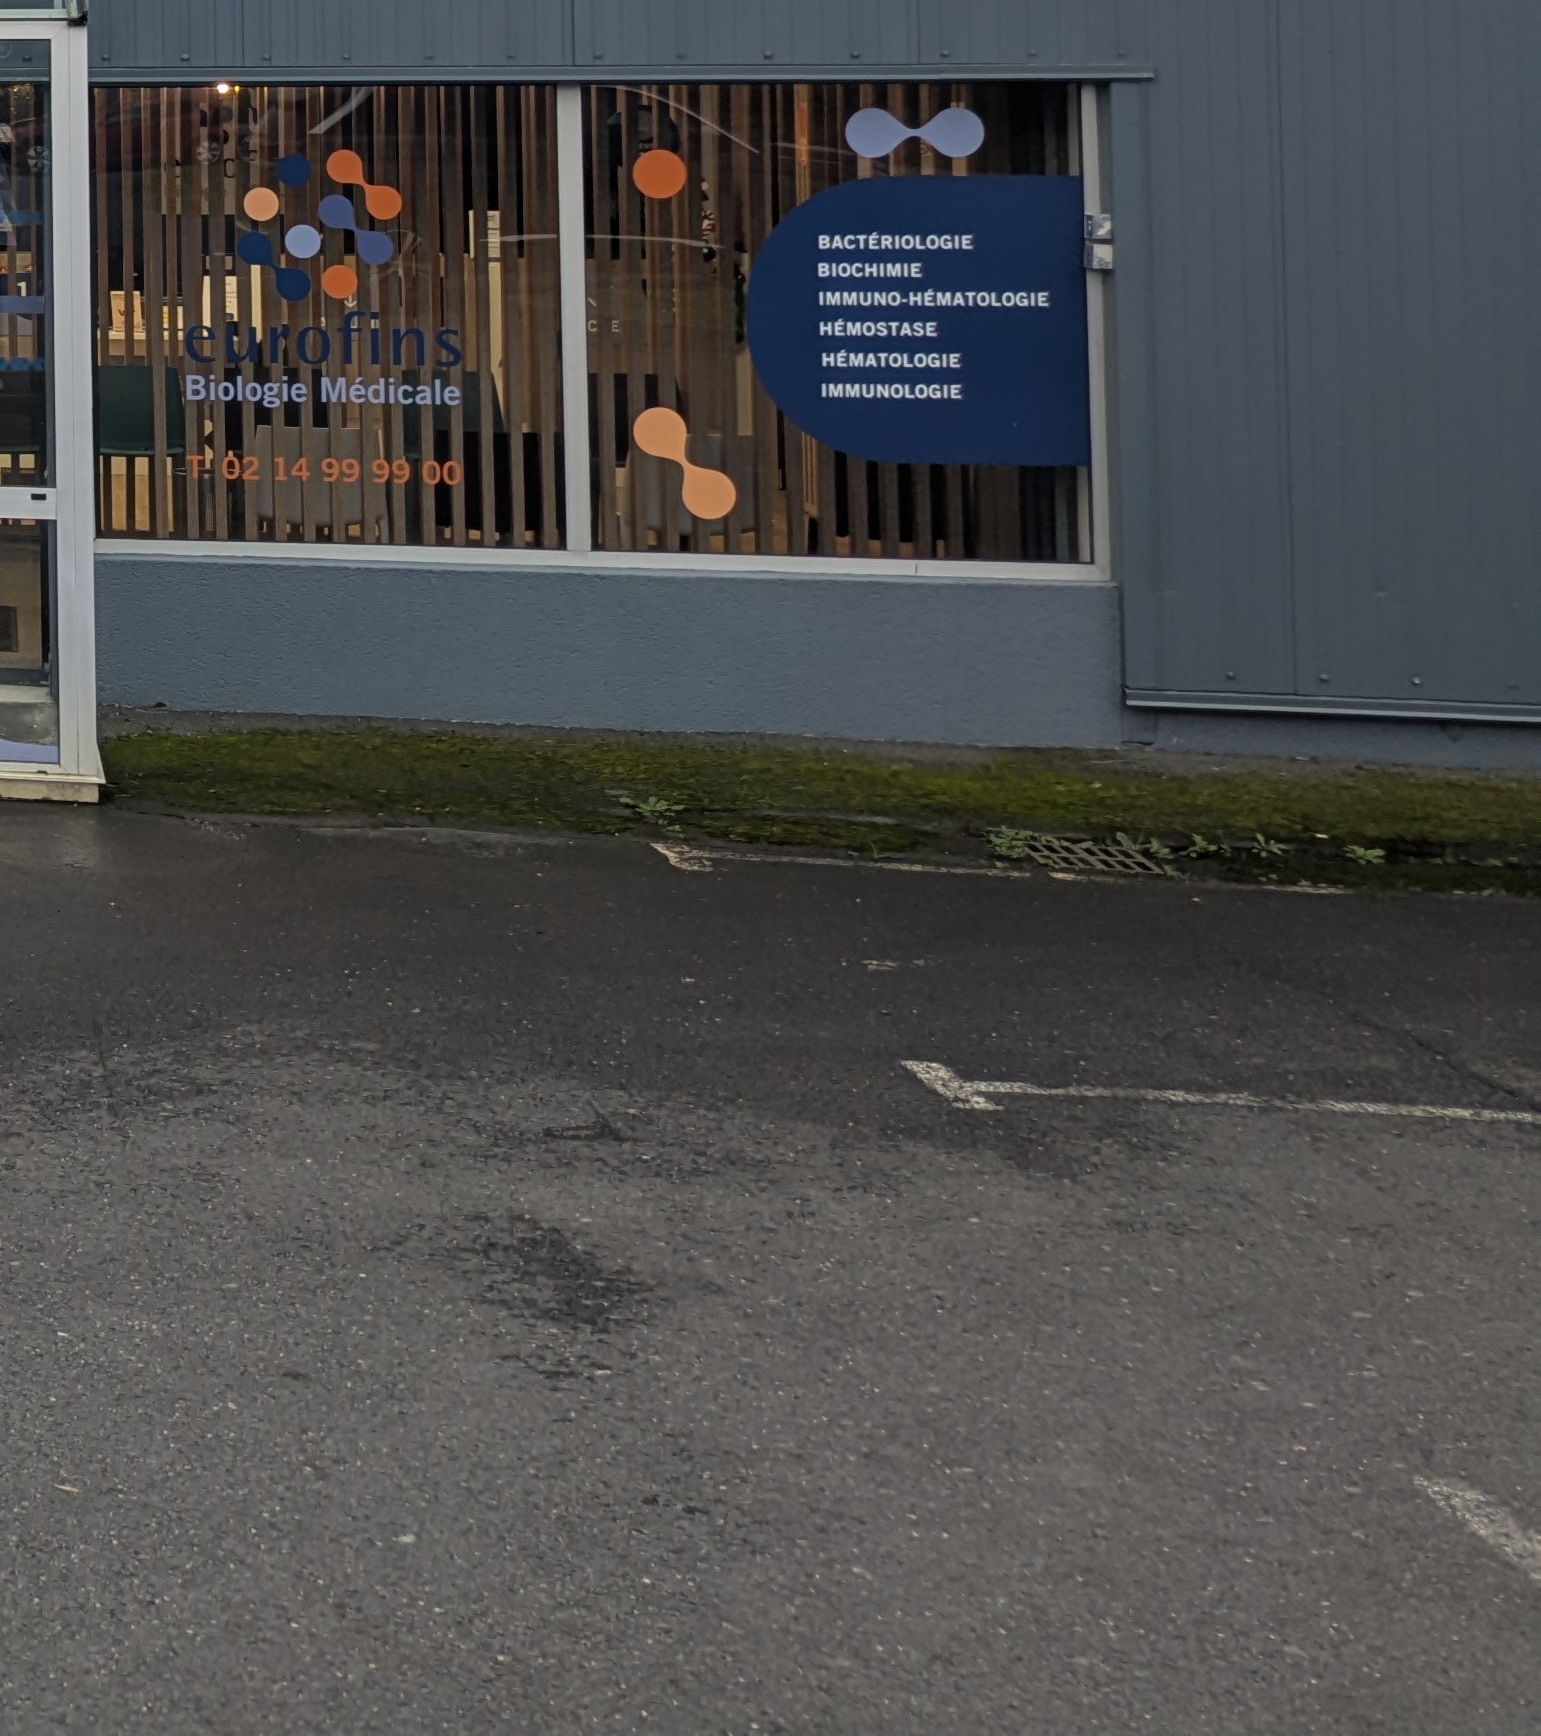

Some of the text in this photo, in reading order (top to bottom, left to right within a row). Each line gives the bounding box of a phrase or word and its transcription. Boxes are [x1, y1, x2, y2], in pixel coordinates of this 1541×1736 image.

[817, 231, 974, 250] BACTÉRIOLOGIE
[817, 262, 923, 278] BIOCHIMIE
[818, 289, 1050, 308] IMMUNO-HÉMATOLOGIE
[819, 318, 938, 337] HÉMOSTASE
[185, 311, 462, 368] eurofins
[821, 349, 962, 368] HÉMATOLOGIE
[185, 374, 462, 408] Biologie Médicale
[821, 383, 963, 400] IMMUNOLOGIE
[187, 455, 463, 486] T. 02 14 99 99 00
